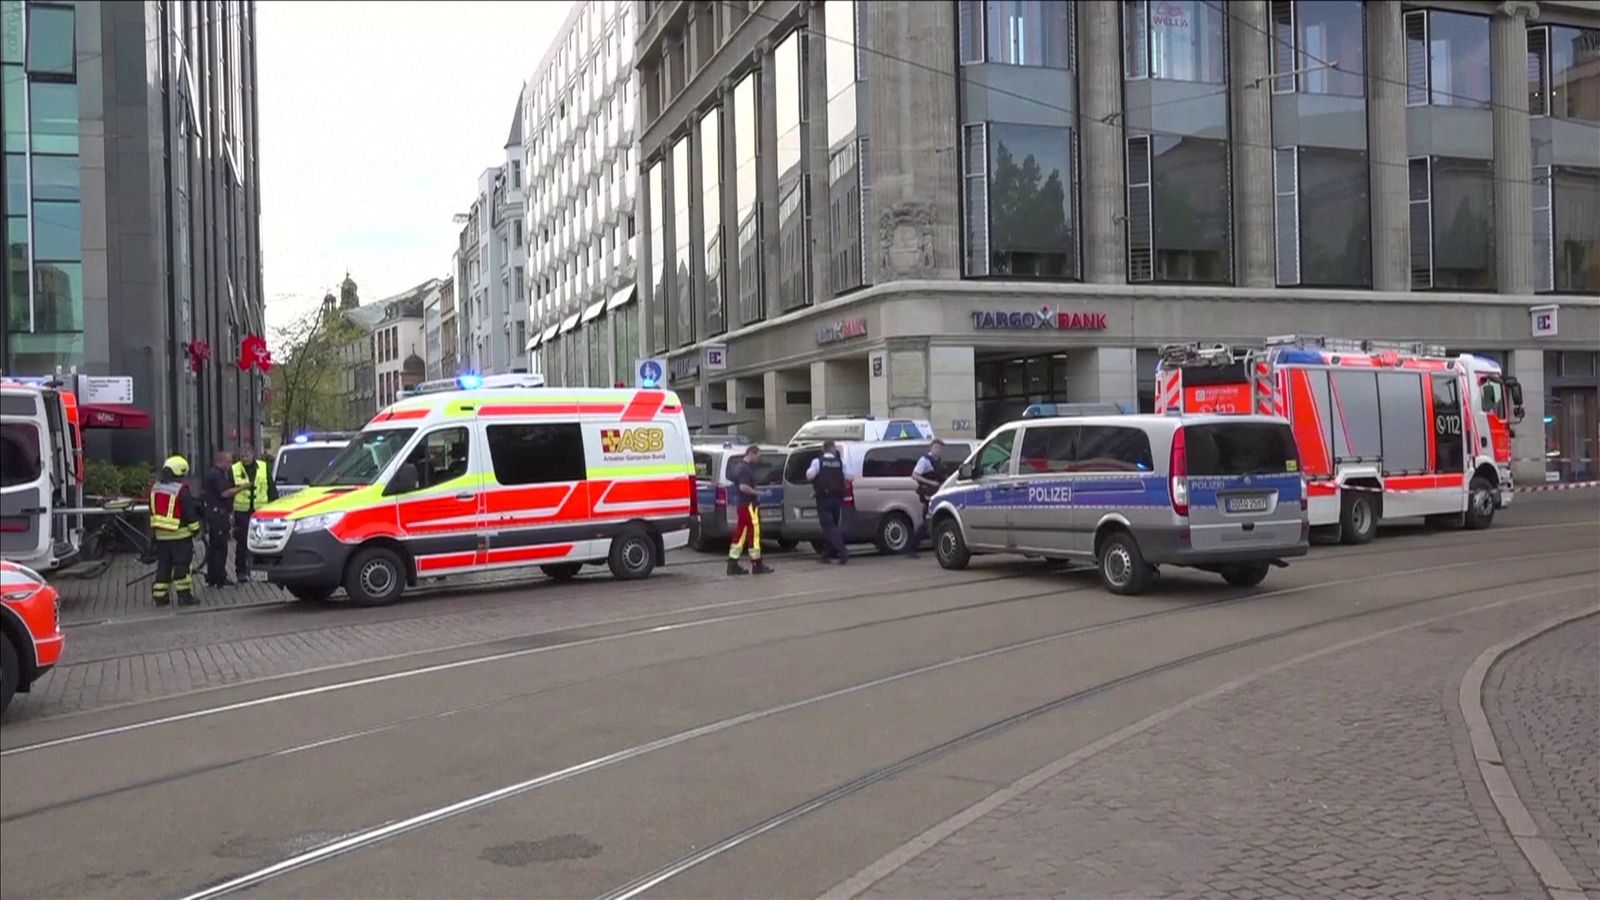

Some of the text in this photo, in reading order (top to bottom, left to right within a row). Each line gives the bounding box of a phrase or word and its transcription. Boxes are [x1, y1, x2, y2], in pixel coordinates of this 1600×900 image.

[1153, 16, 1188, 28] WELLA
[971, 311, 1108, 330] TARGO BANK
[1446, 415, 1461, 434] 112
[616, 427, 665, 453] ASB
[1191, 480, 1225, 491] POLIZEI
[1029, 487, 1074, 502] POLIZEI
